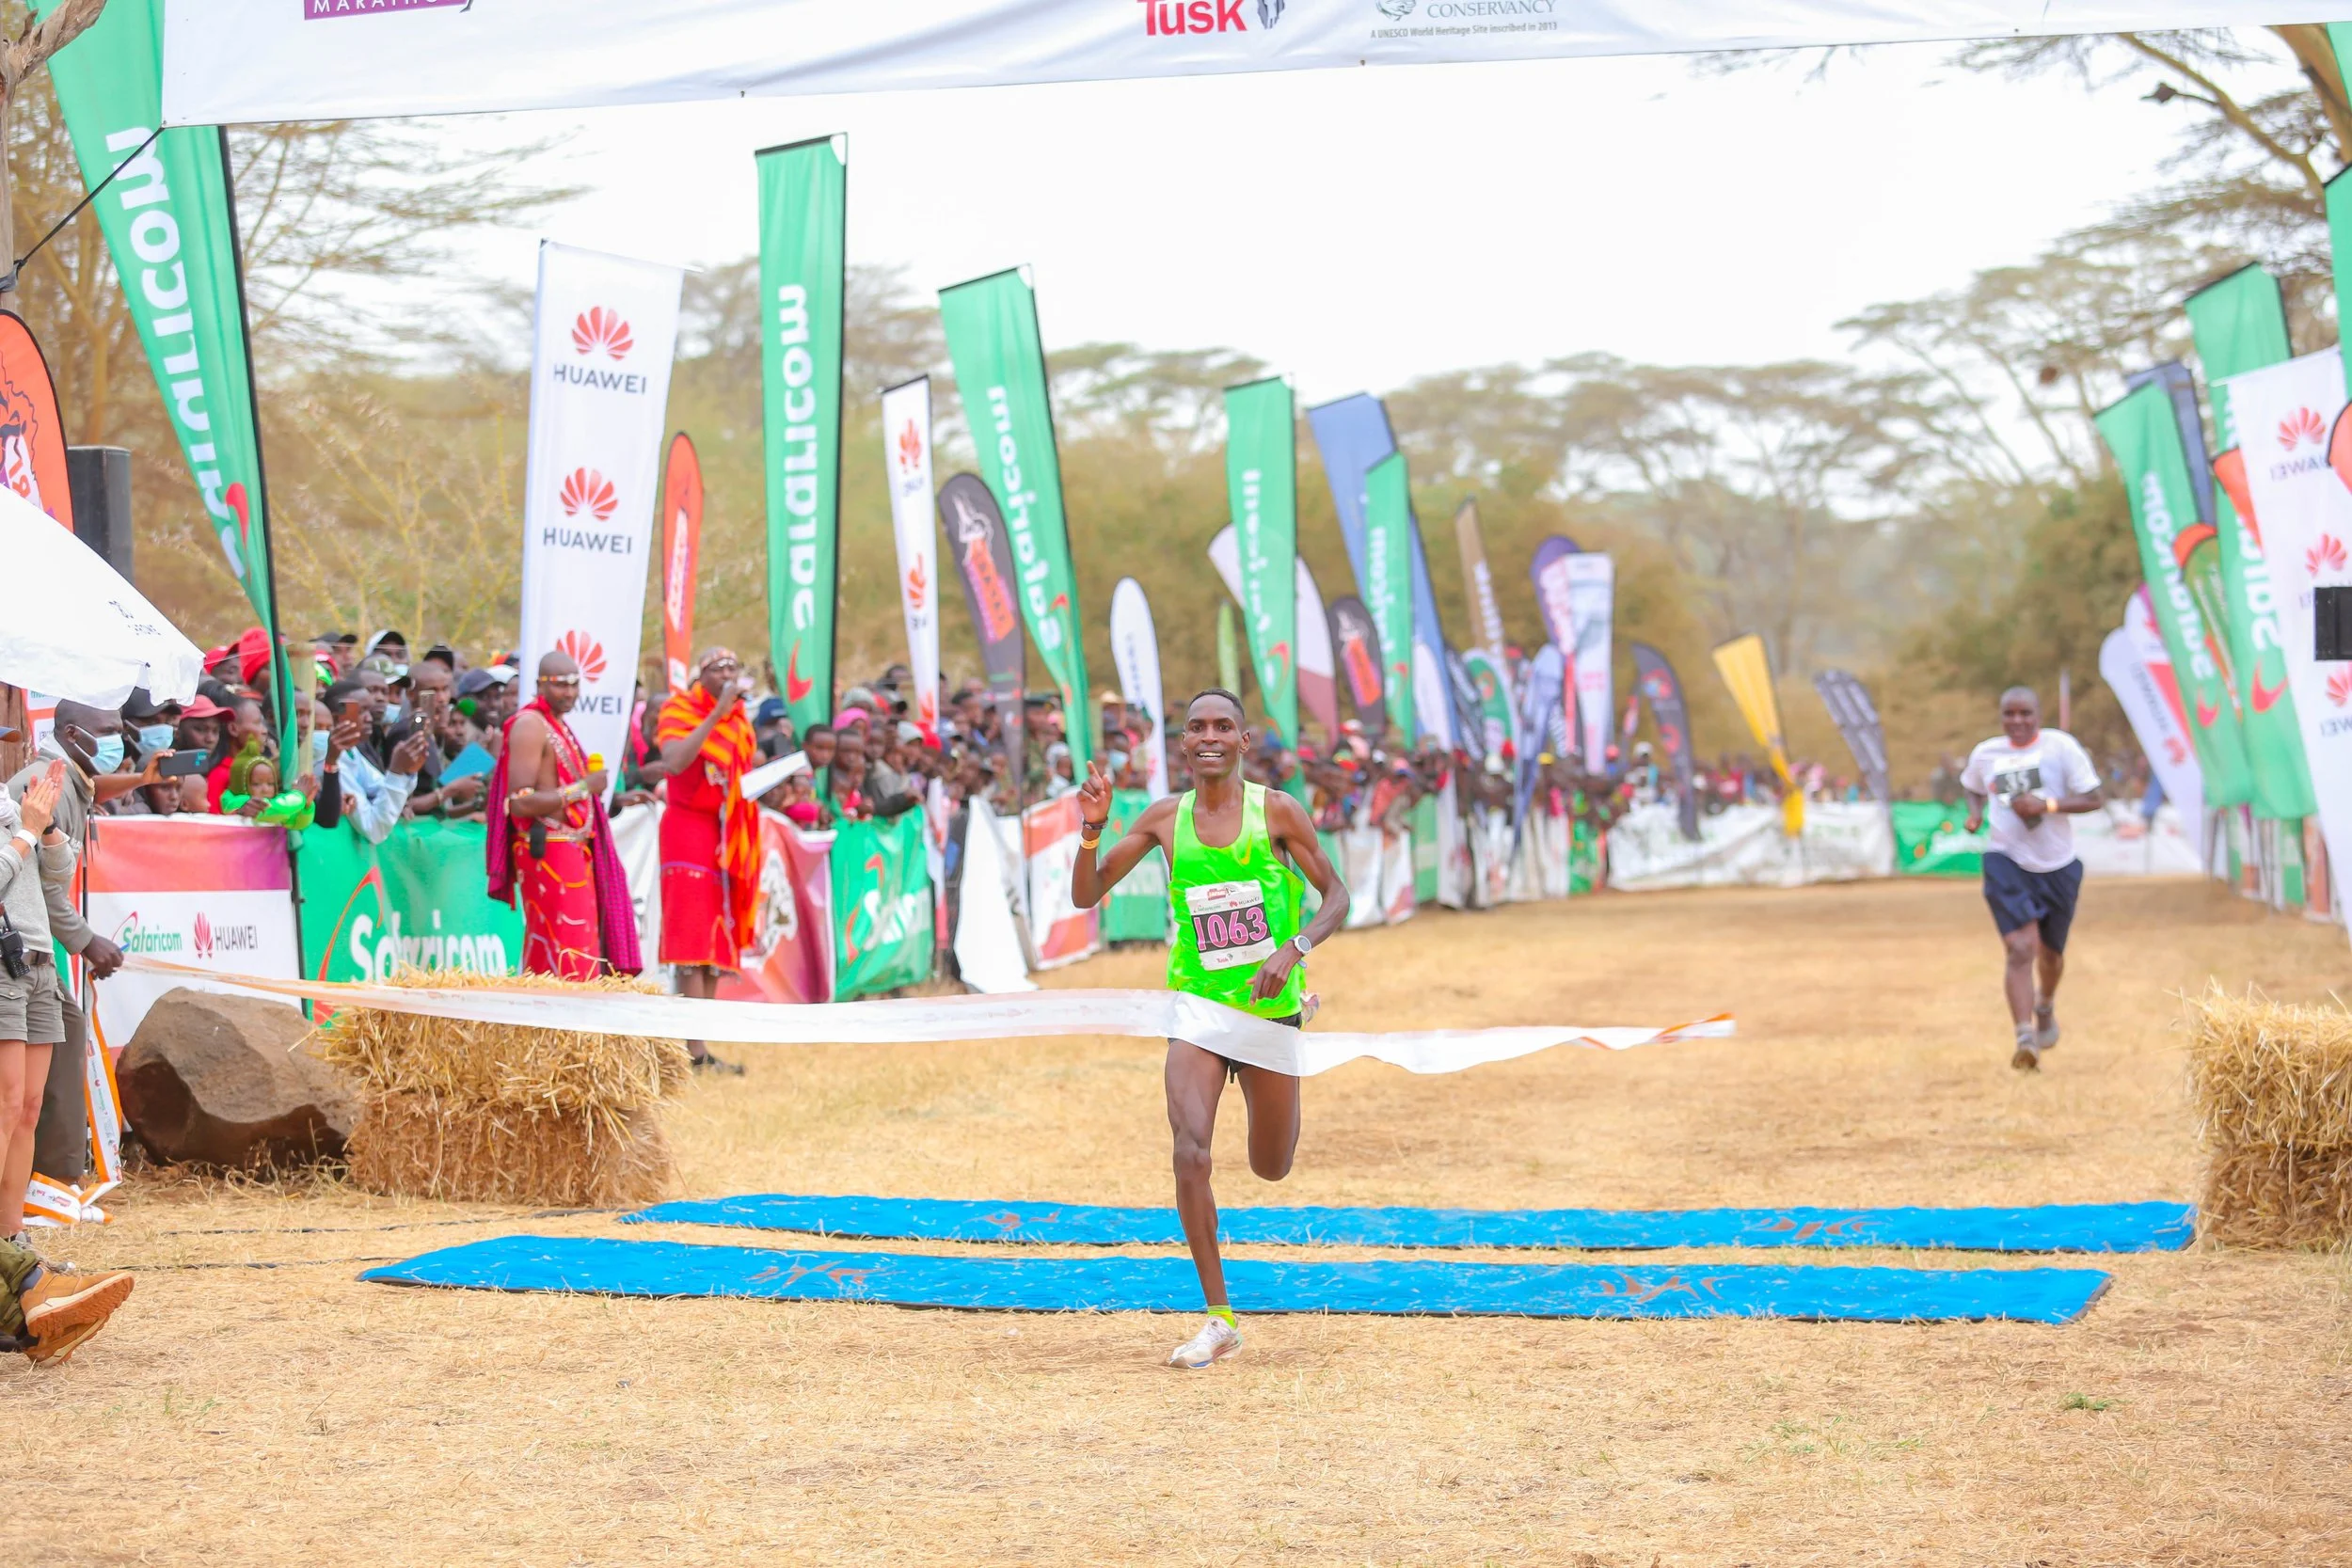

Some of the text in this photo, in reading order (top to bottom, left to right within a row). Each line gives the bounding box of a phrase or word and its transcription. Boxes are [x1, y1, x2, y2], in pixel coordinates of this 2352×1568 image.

[1136, 0, 1248, 37] Tusk
[1426, 0, 1557, 19] CONSERVANCY
[1377, 28, 1408, 39] UNESCO
[1410, 26, 1434, 37] World
[1435, 24, 1470, 37] Heritage
[1472, 24, 1487, 34] Site
[1489, 23, 1527, 33] inscribed
[1528, 22, 1536, 32] in
[1538, 22, 1558, 31] 2013
[553, 363, 647, 395] HUAWEI
[543, 527, 633, 555] HUAWEI
[122, 925, 258, 953] Safaricom HUAWEI
[1193, 907, 1268, 951] 1063
